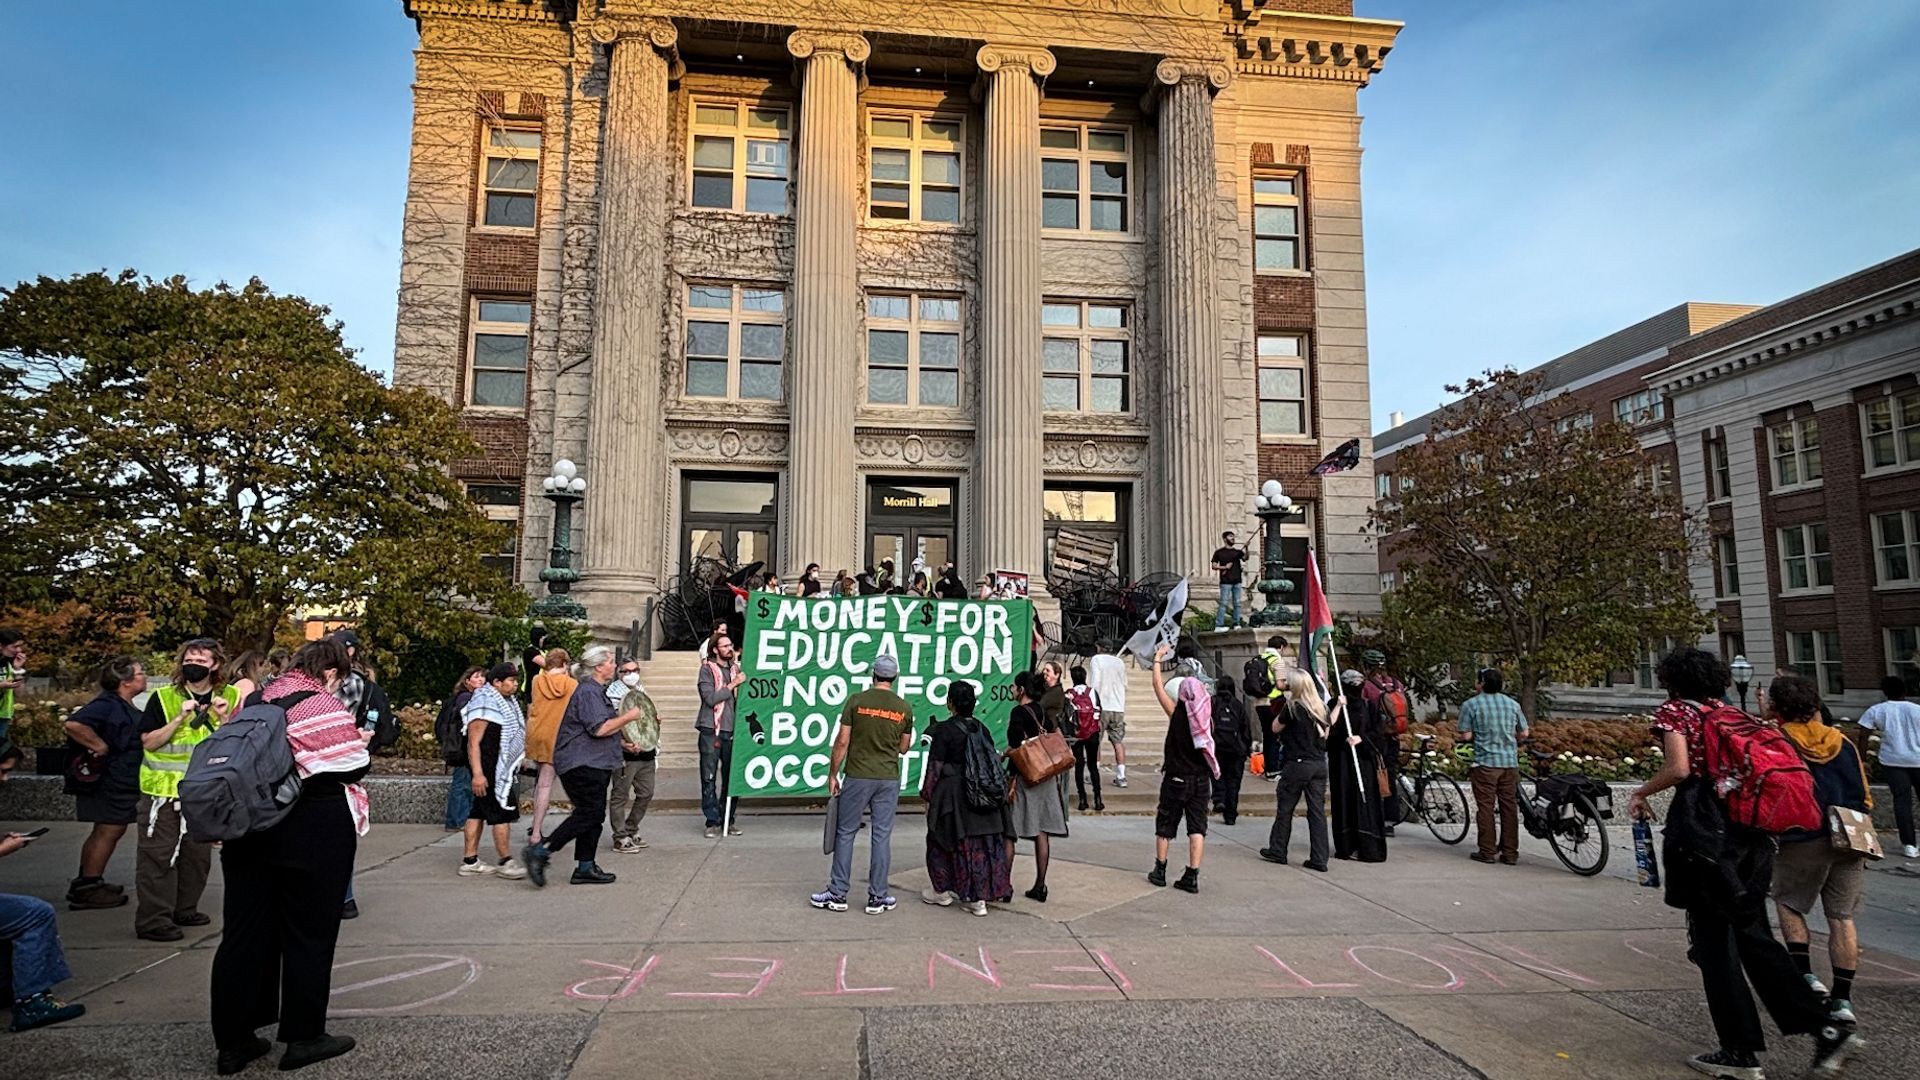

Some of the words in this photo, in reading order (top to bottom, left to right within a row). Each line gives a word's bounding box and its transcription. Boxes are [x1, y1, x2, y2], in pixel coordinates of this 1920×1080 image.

[884, 496, 917, 507] Morrill
[918, 496, 938, 507] Hall
[773, 596, 920, 632] MONEY
[936, 602, 1013, 638] FOR
[756, 630, 1013, 675] EDUCATION
[748, 677, 779, 699] SDS
[563, 945, 1133, 999] ENTER
